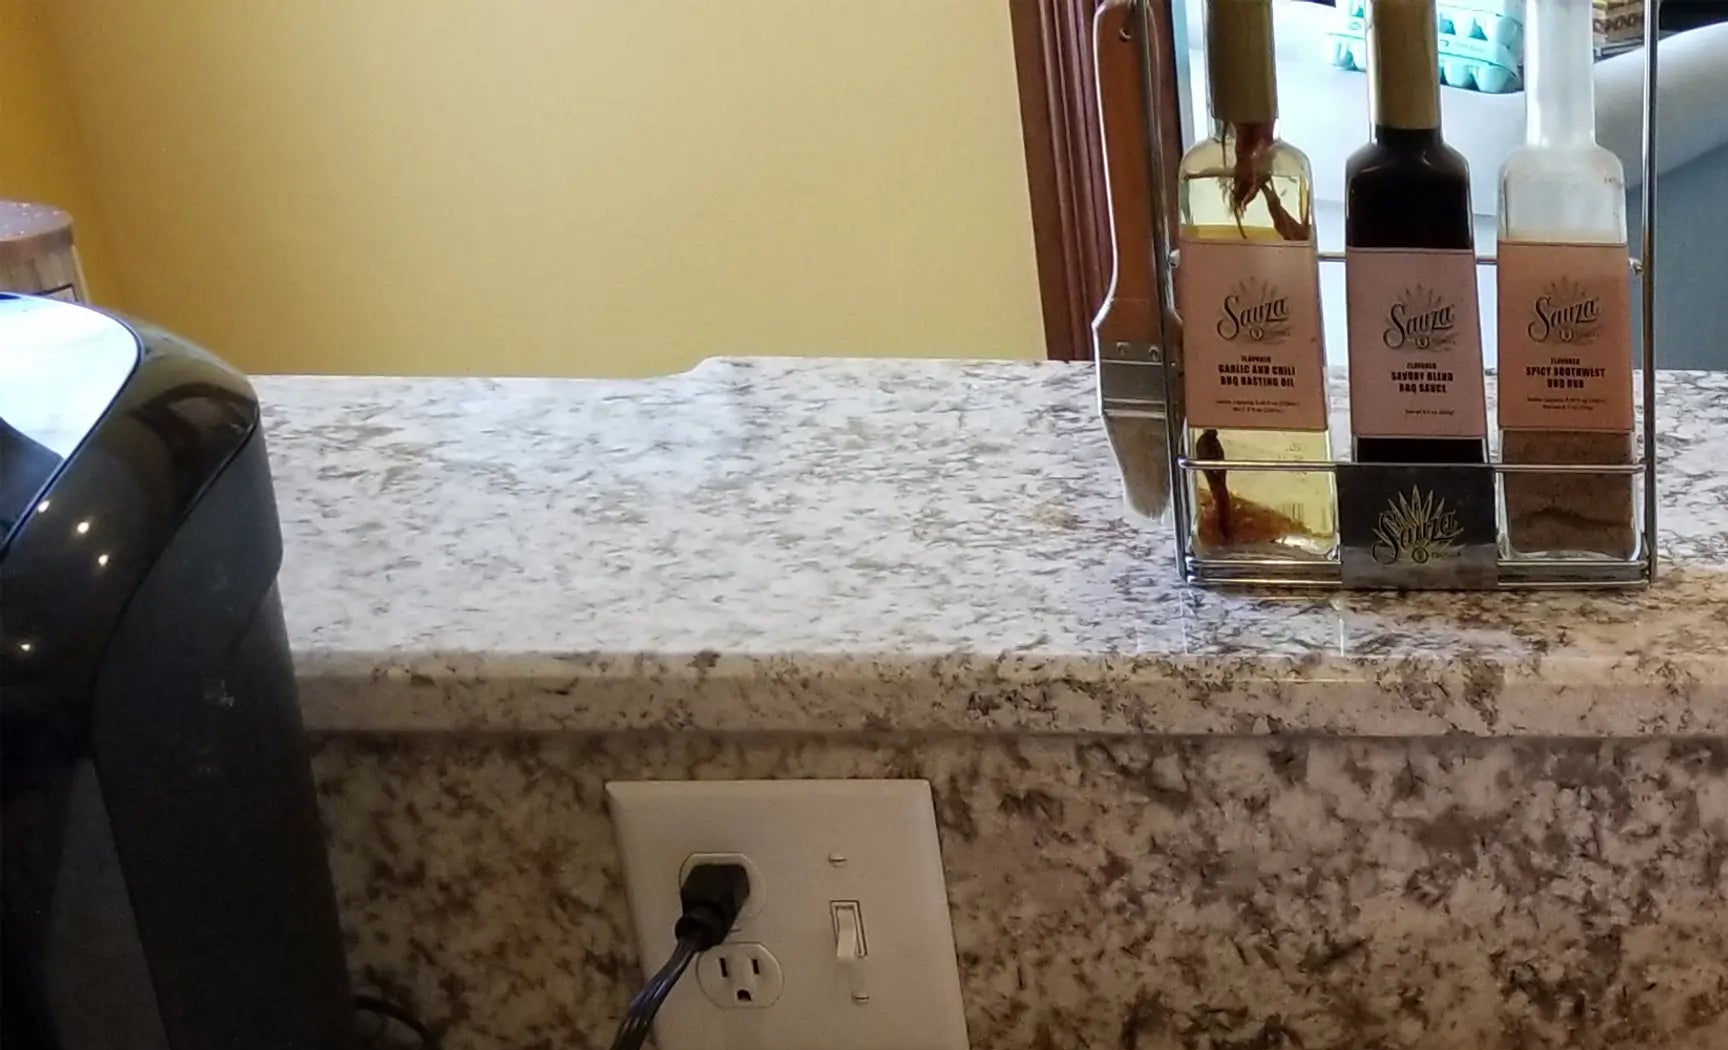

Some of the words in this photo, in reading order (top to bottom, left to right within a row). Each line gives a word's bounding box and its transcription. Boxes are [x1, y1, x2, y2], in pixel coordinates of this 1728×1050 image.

[1216, 295, 1289, 341] Sauza
[1528, 296, 1598, 343] Sauza
[1383, 304, 1455, 349] Sauza
[1218, 364, 1250, 374] GARLIC
[1252, 365, 1270, 375] AND
[1272, 366, 1296, 376] CHILI
[1526, 366, 1551, 376] SPICY
[1553, 367, 1606, 377] SOUTHWEST
[1280, 378, 1295, 387] OIL
[1391, 371, 1424, 381] SAVORY
[1426, 372, 1454, 382] BLEND
[1399, 383, 1417, 393] BBQ
[1418, 384, 1447, 393] SAUCE
[1371, 511, 1460, 565] Sauza
